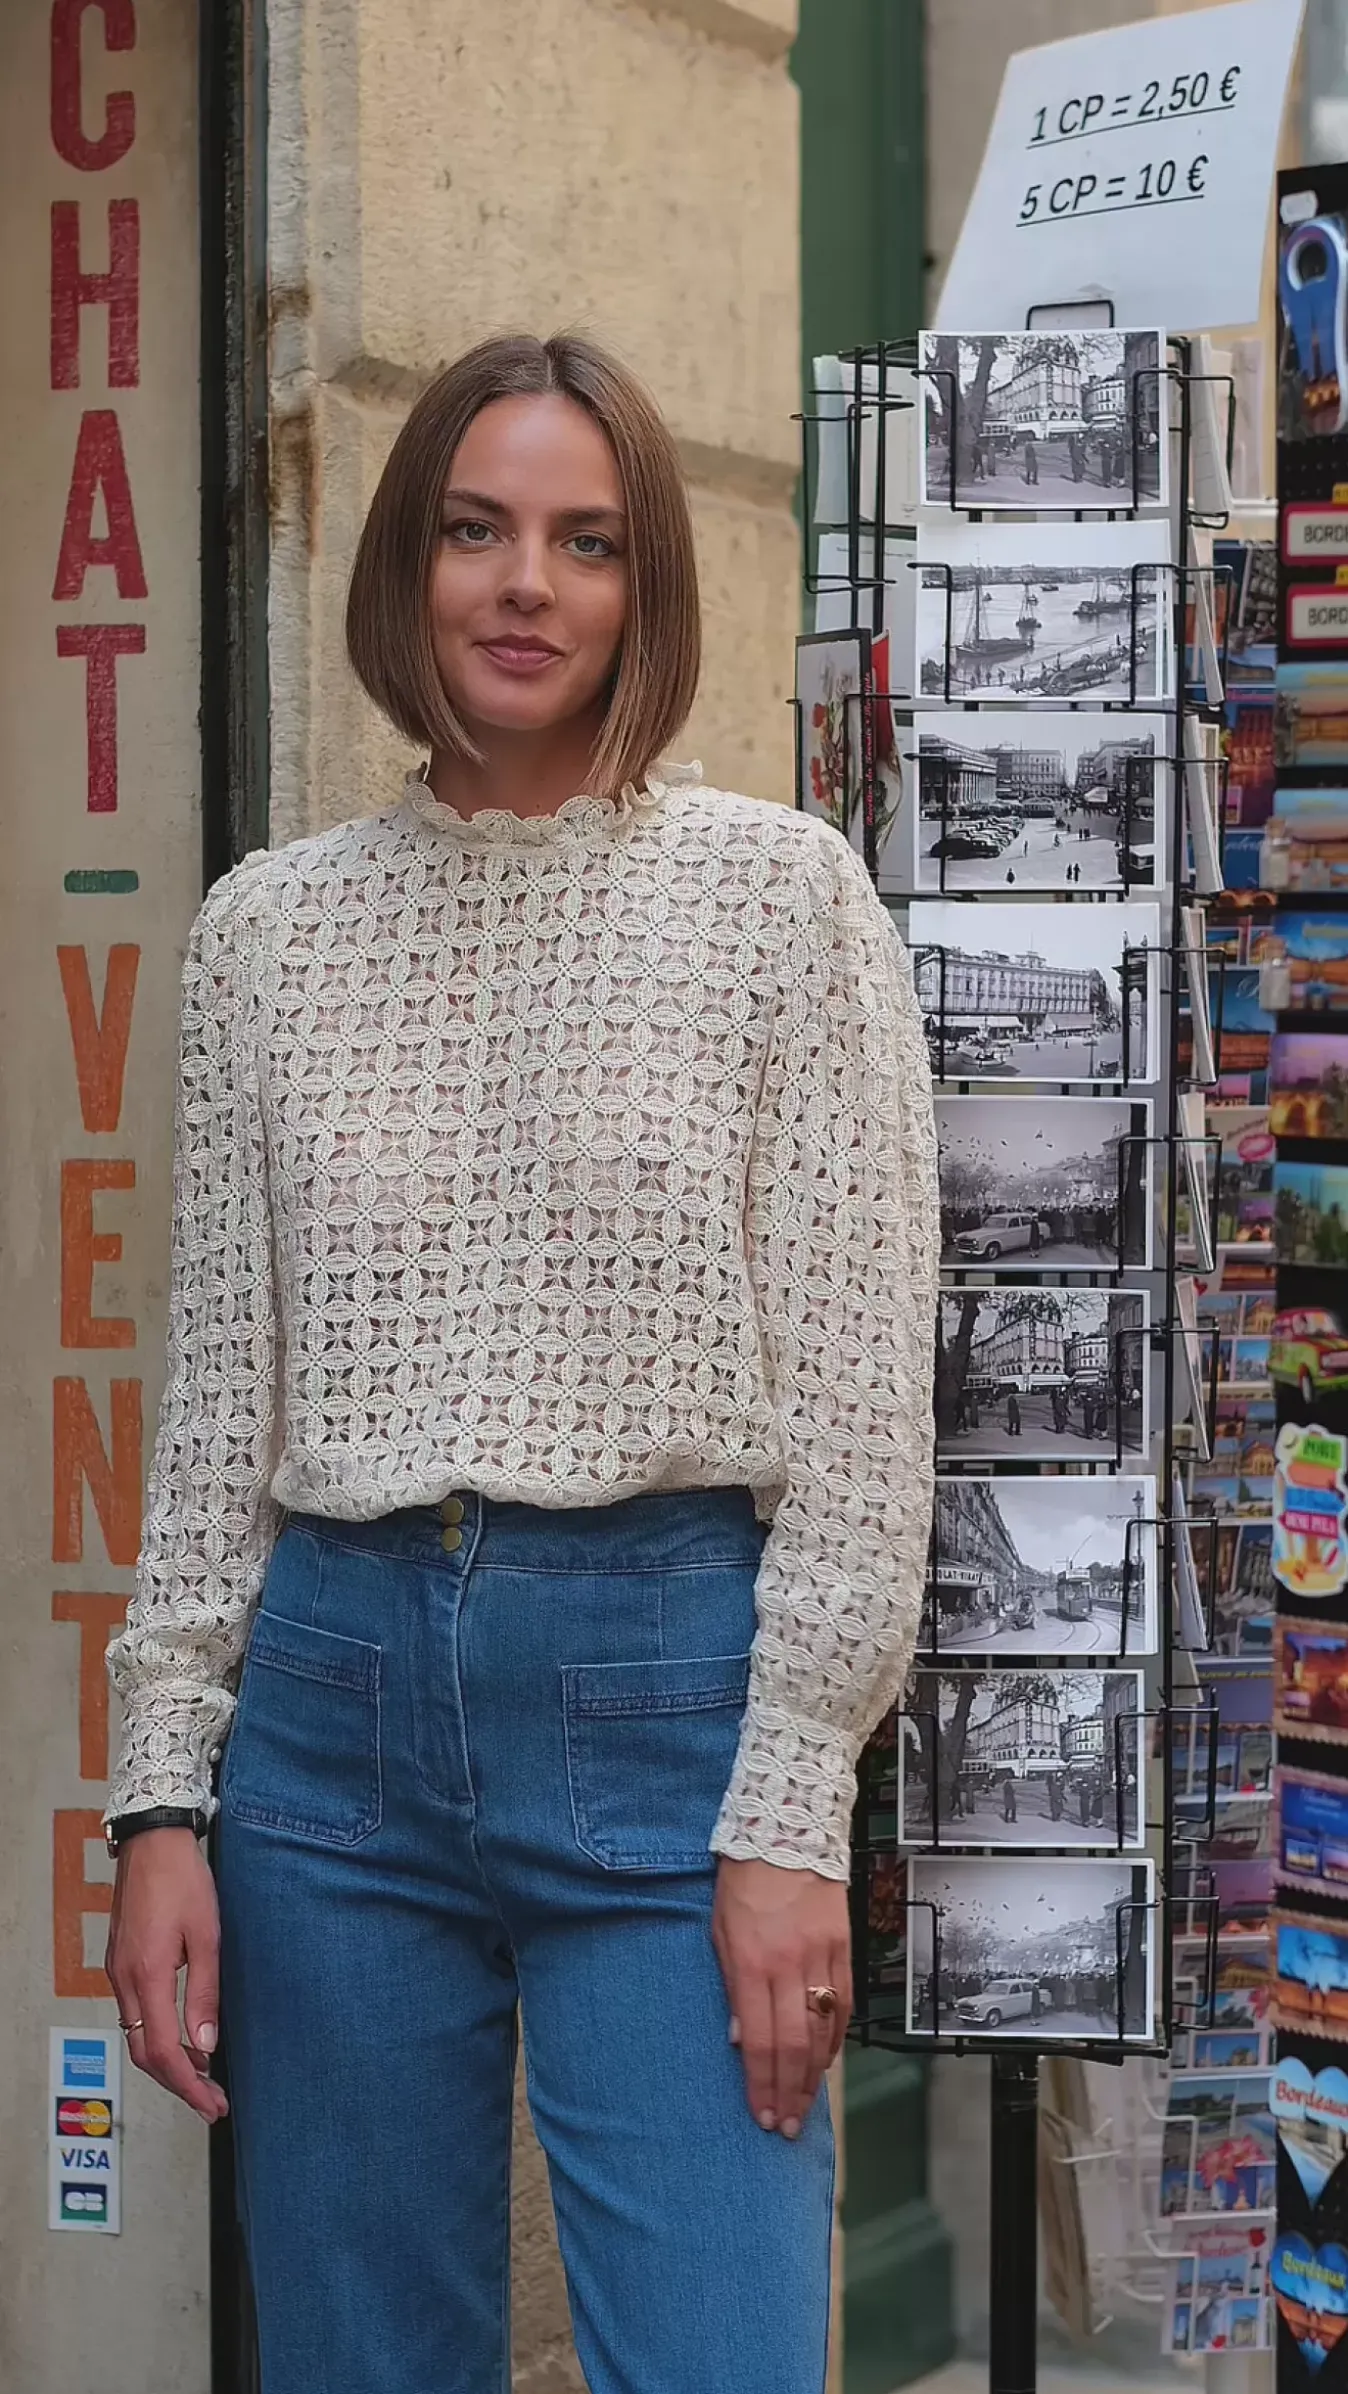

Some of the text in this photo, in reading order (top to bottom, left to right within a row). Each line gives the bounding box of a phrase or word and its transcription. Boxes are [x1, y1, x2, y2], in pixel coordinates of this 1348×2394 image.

[1030, 66, 1241, 142] 1 CP = 2,50 €
[1021, 155, 1209, 220] 5 CP = 10 €
[1304, 524, 1348, 544] BORD
[52, 945, 140, 1998] VENTE
[60, 2147, 110, 2170] VISA
